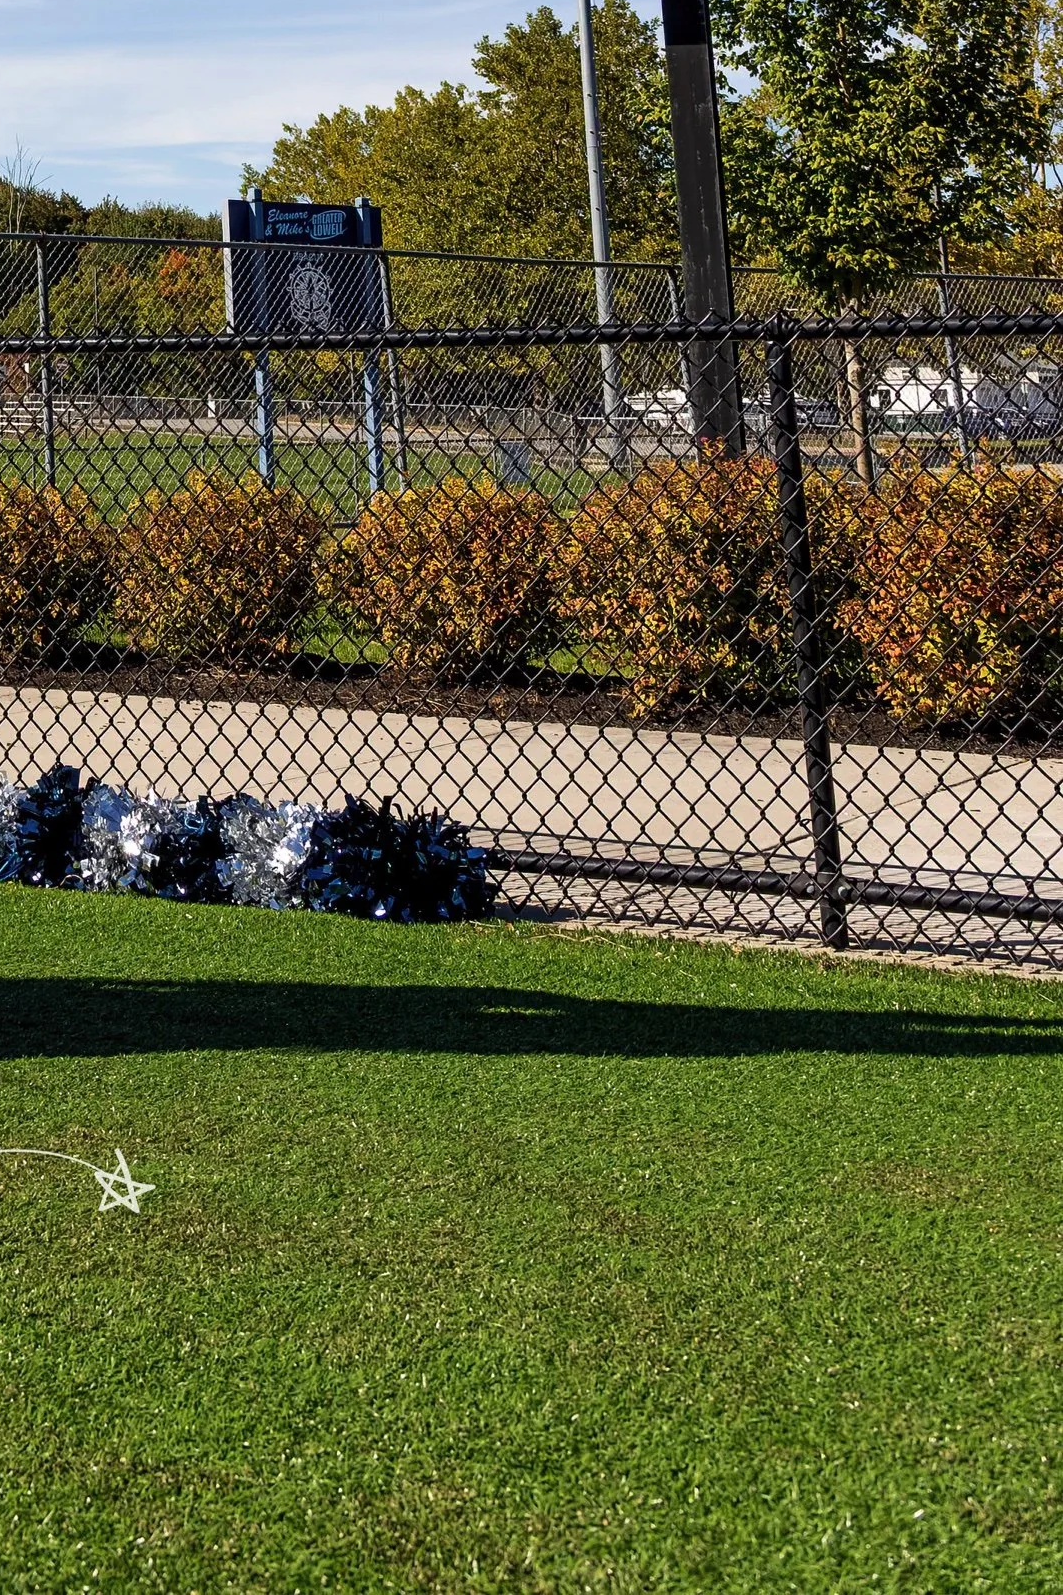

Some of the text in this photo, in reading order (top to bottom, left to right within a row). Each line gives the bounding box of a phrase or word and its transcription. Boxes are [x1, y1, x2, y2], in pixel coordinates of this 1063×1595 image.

[312, 212, 343, 225] GREATER
[264, 221, 310, 236] & Mike's
[313, 223, 343, 237] LOWELL
